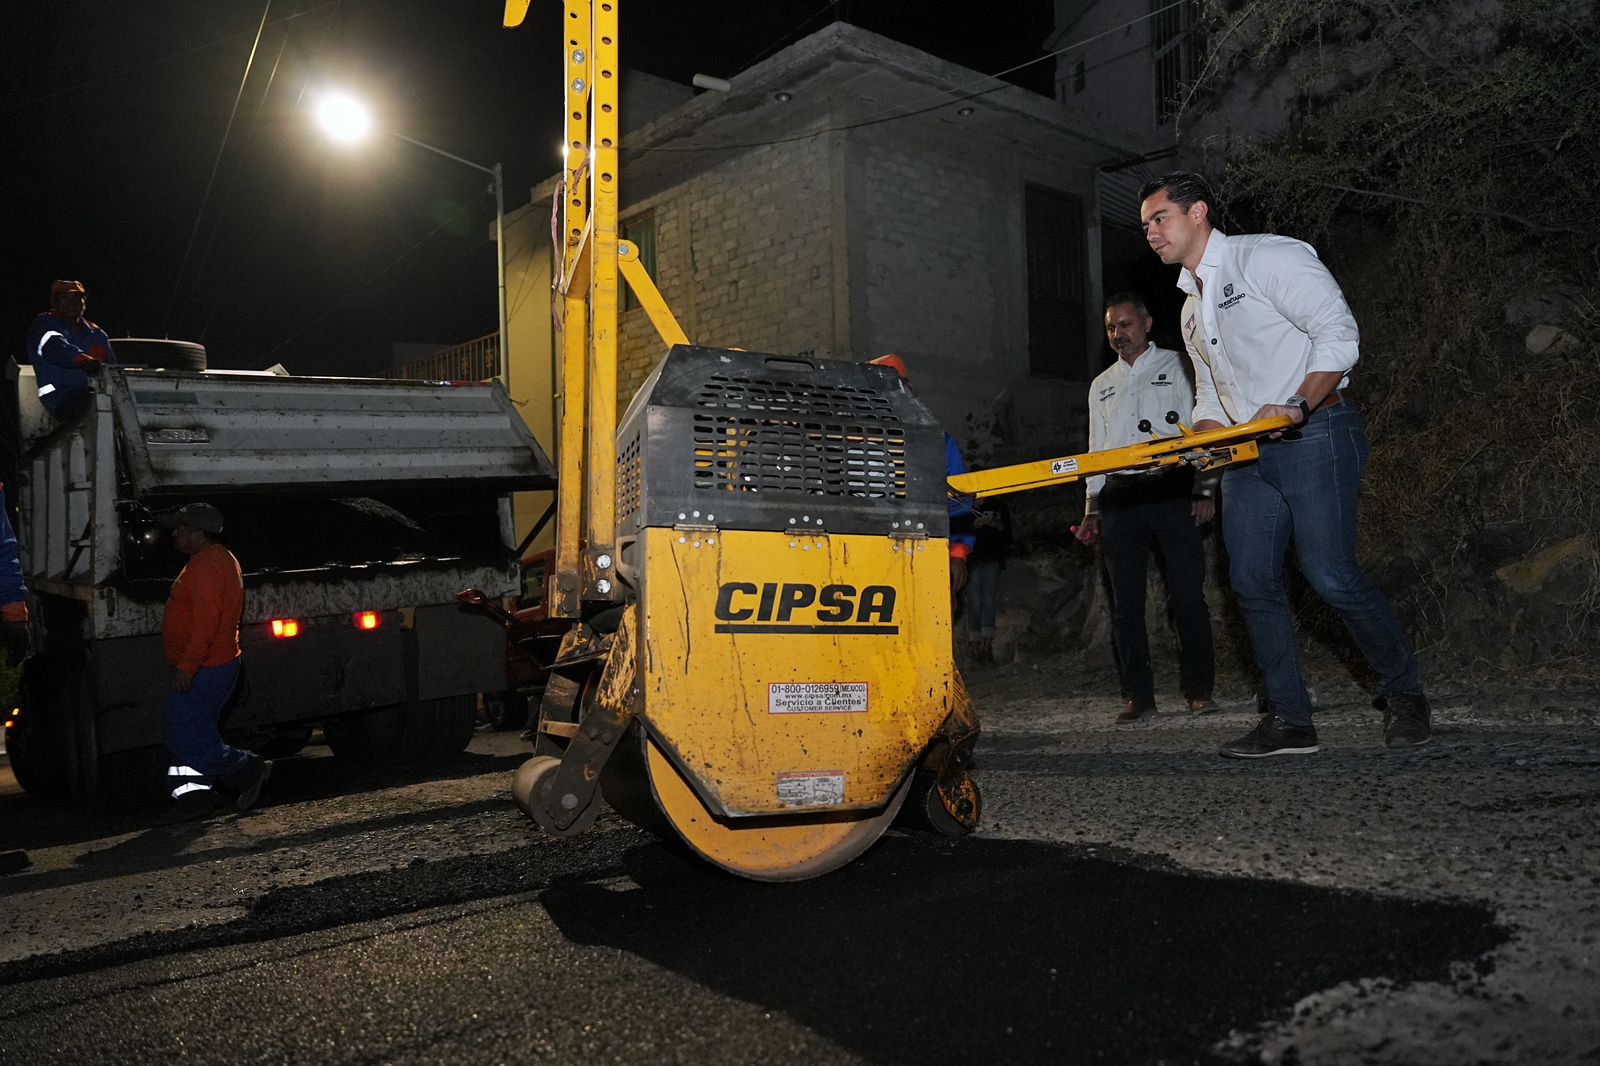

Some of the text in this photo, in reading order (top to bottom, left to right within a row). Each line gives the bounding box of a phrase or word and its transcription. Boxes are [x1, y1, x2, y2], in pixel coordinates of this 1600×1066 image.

[714, 582, 897, 622] CIPSA
[771, 684, 839, 694] 01-800-0126959
[775, 699, 814, 707] Servicio
